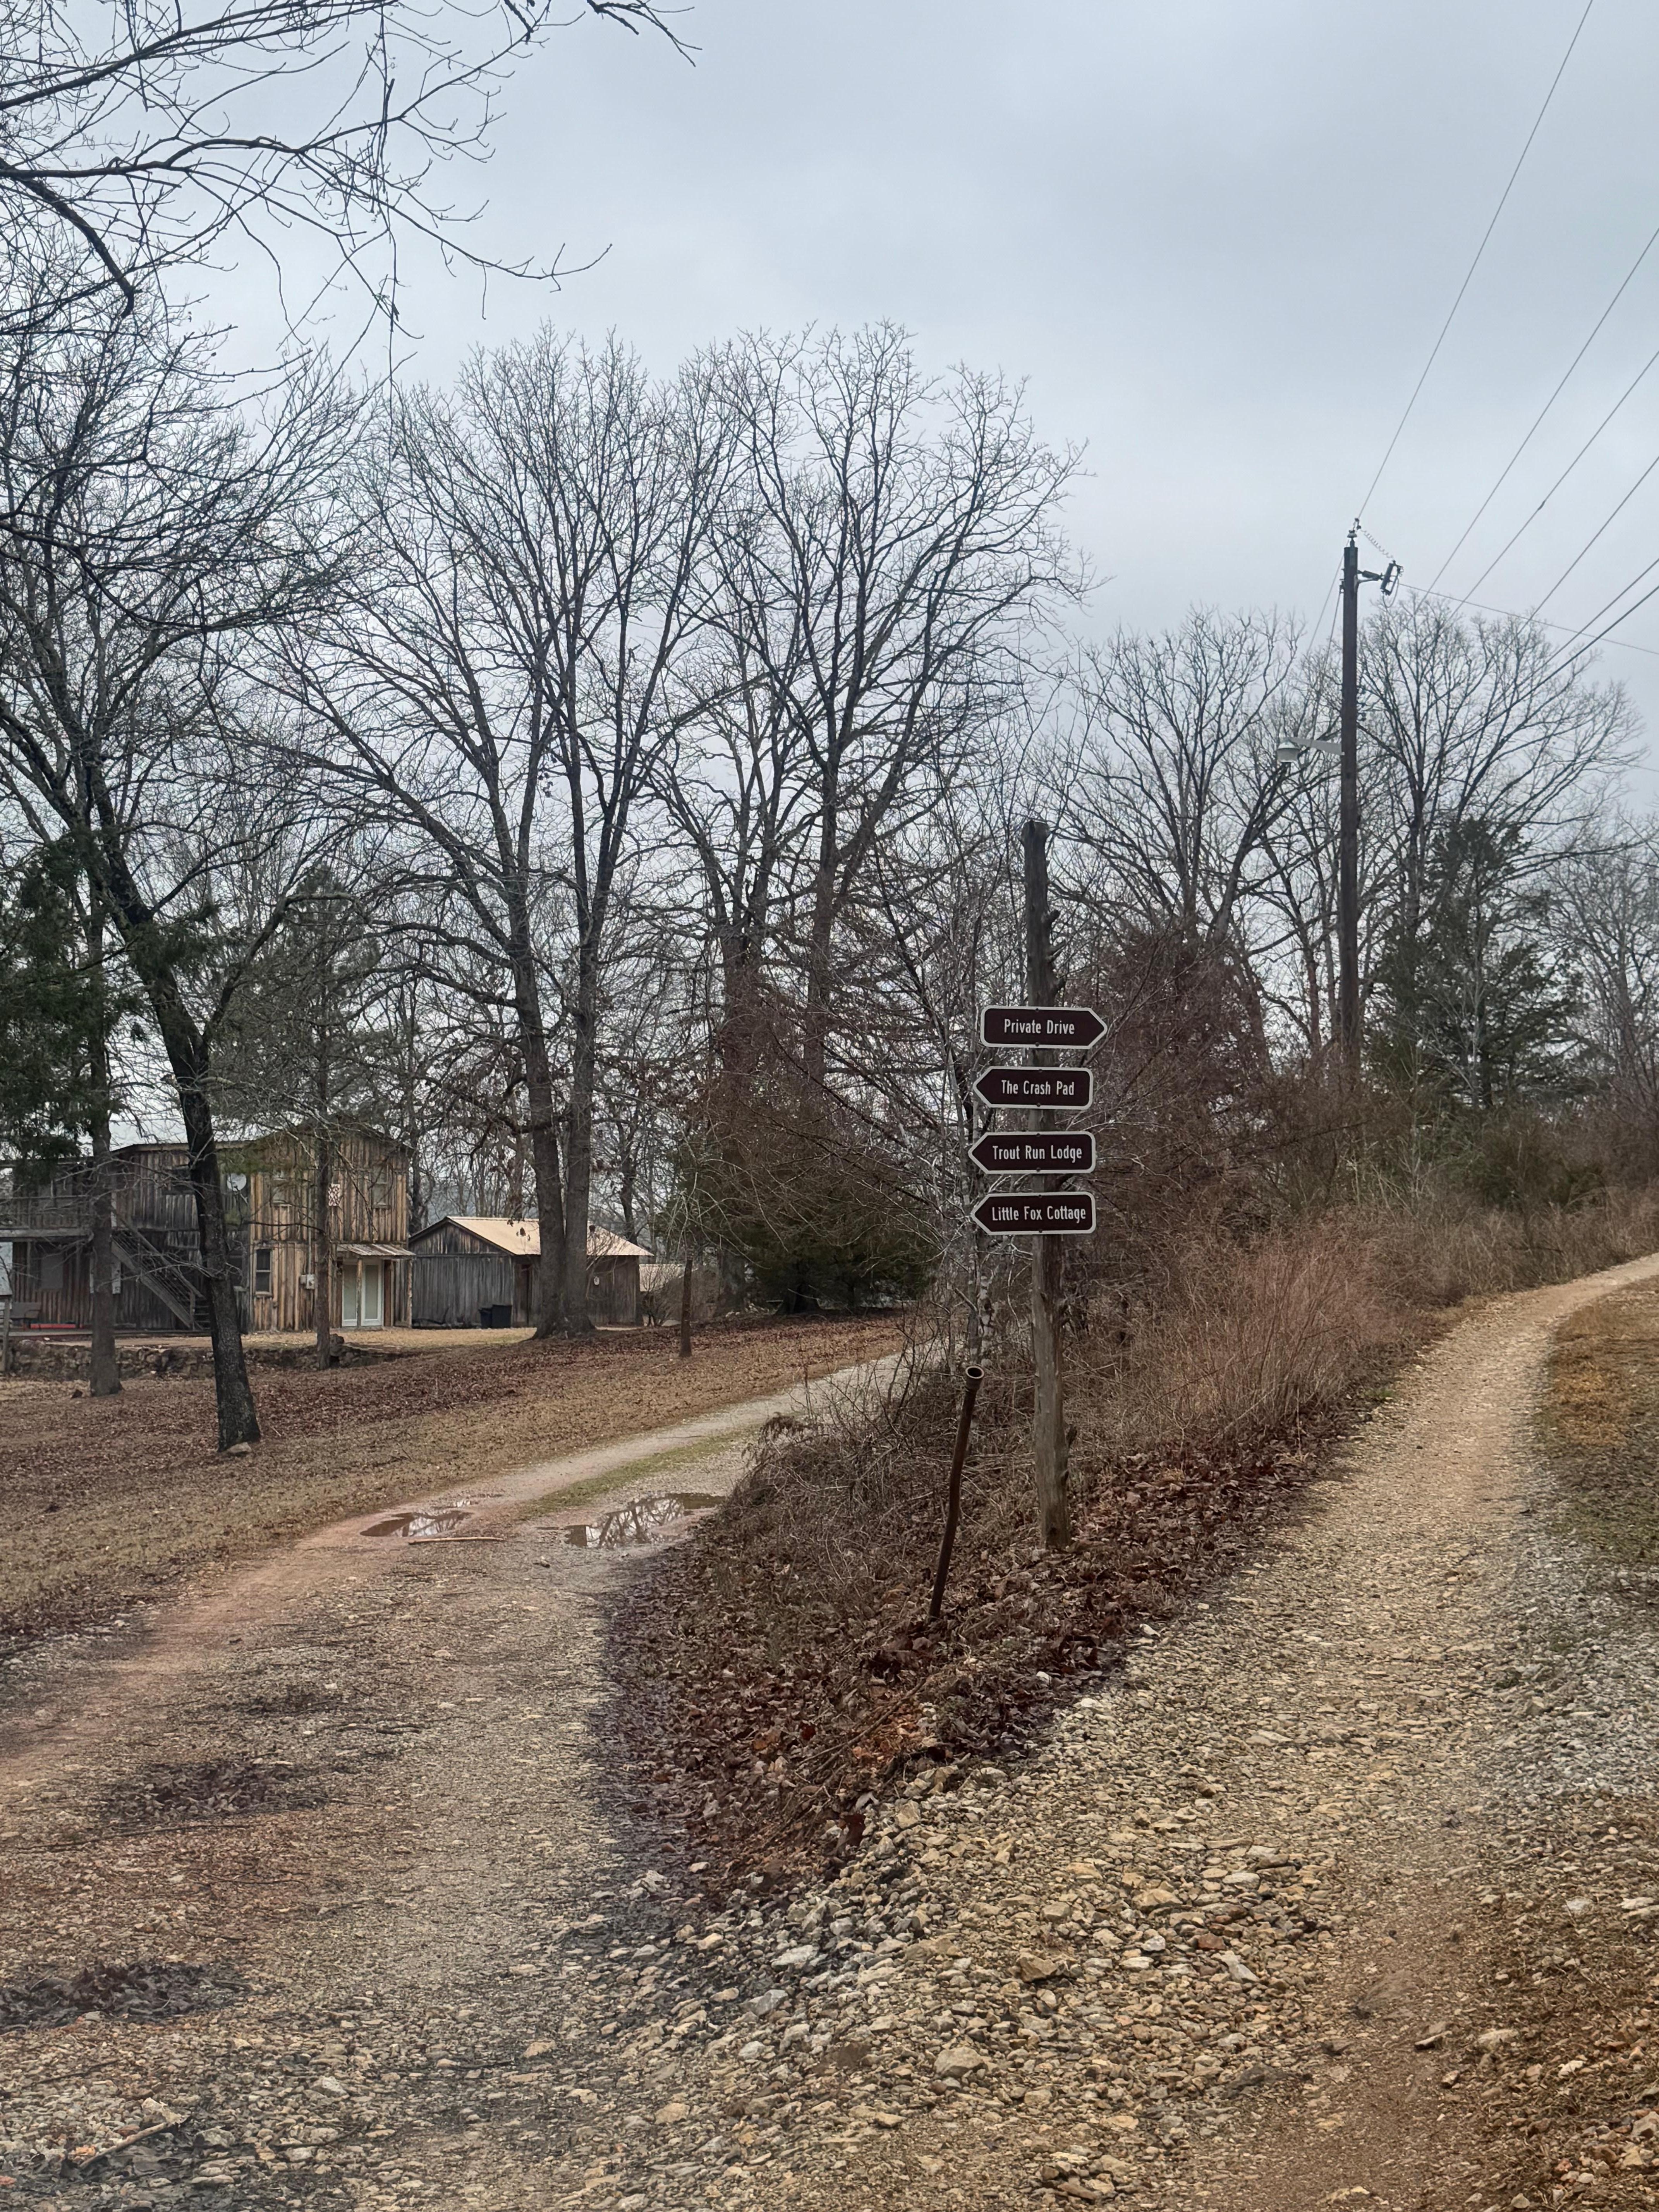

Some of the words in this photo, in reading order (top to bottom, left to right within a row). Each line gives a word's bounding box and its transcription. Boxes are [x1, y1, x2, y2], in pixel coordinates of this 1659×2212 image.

[1004, 1019, 1041, 1033] Private
[1047, 1020, 1075, 1034] Drive
[1001, 1080, 1018, 1094] The
[1024, 1080, 1051, 1095] Crash
[1056, 1081, 1074, 1095] Pad
[993, 1146, 1020, 1160] Trout
[1025, 1145, 1045, 1159] Run
[1051, 1145, 1082, 1163] Lodge
[992, 1207, 1019, 1221] Little
[1024, 1206, 1042, 1220] Fox
[1047, 1206, 1086, 1224] Cottage
